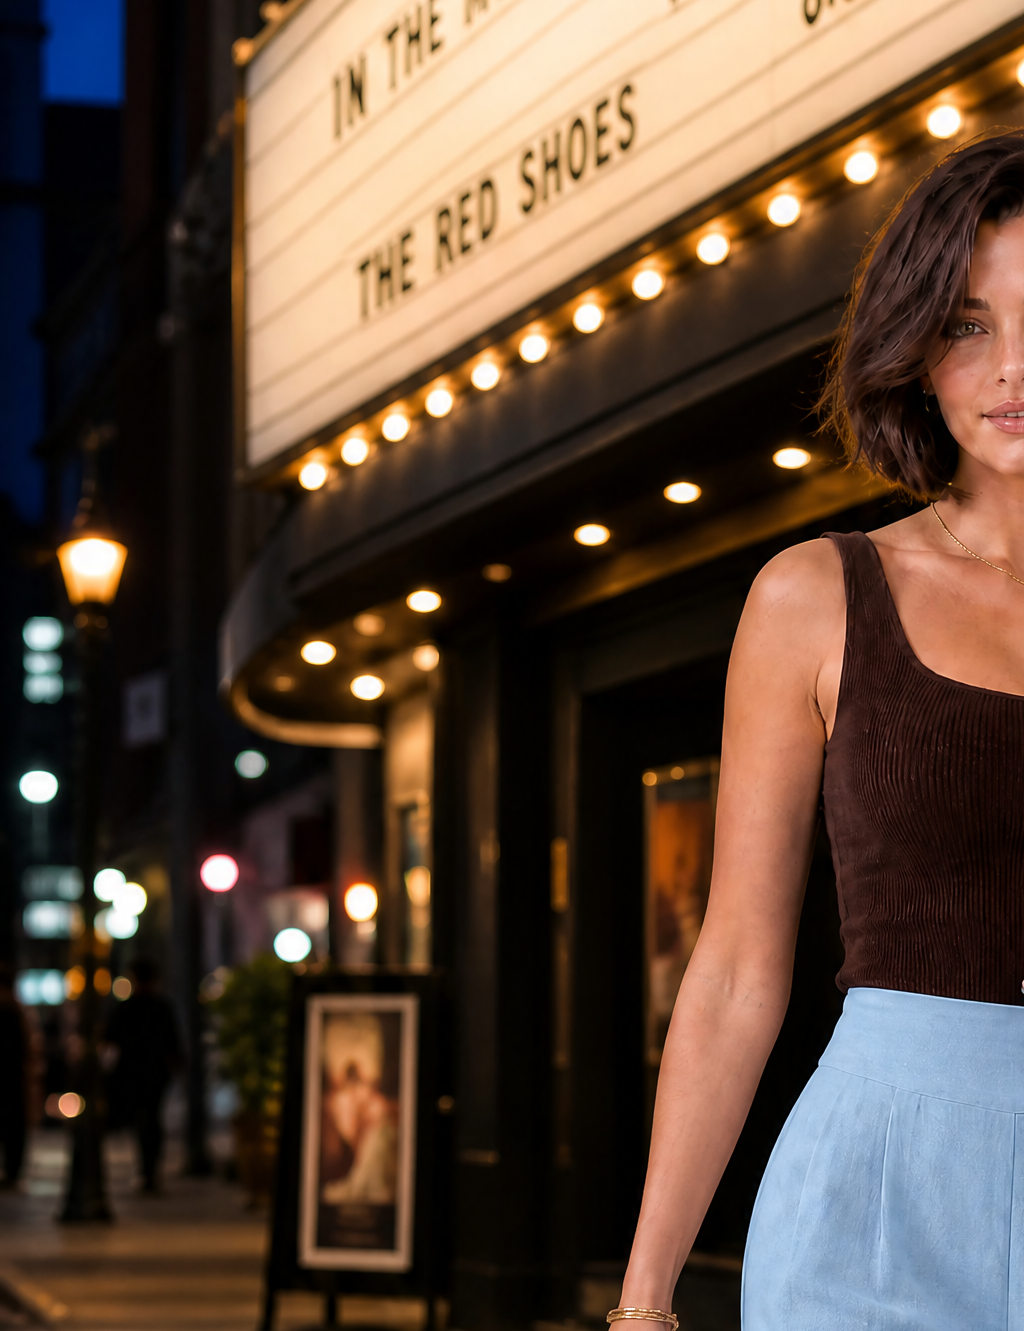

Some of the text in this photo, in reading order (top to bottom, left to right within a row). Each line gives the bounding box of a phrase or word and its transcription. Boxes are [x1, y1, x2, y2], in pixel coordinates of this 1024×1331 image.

[333, 0, 443, 141] IN THE
[357, 83, 636, 320] THE RED SHOES
